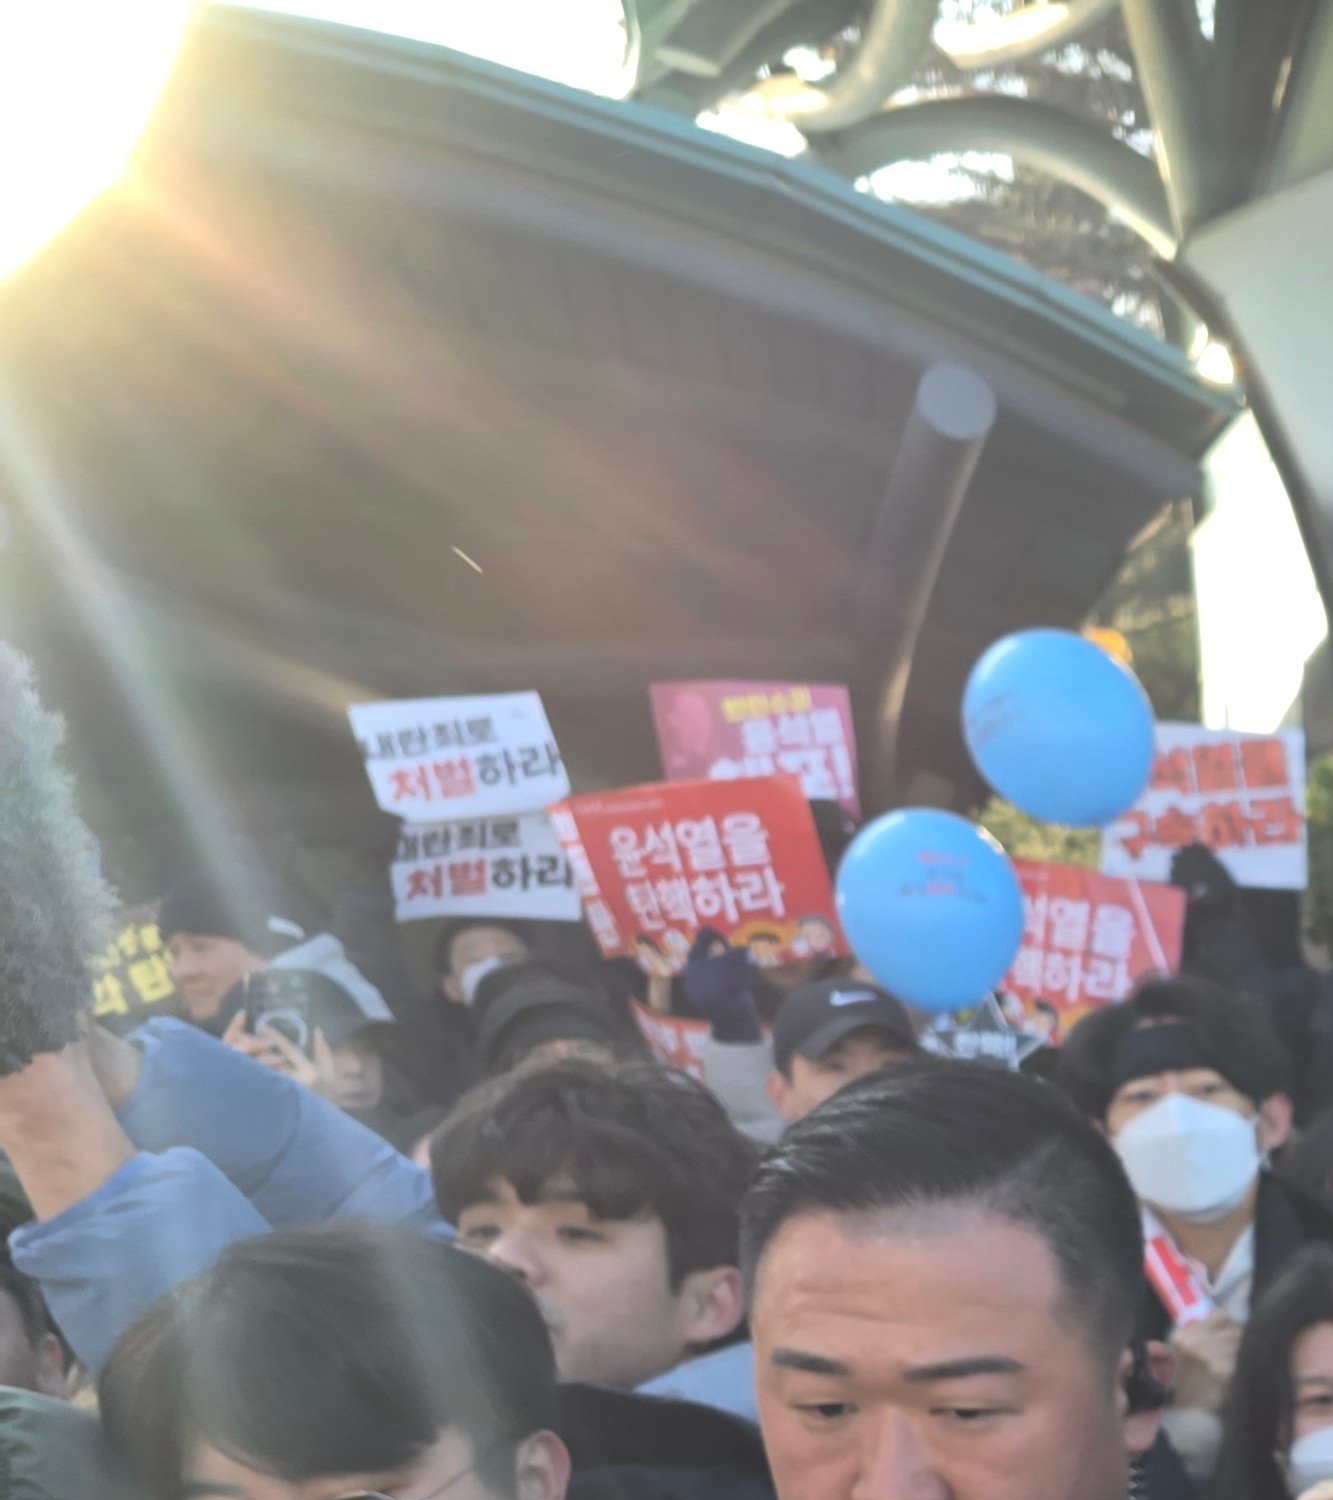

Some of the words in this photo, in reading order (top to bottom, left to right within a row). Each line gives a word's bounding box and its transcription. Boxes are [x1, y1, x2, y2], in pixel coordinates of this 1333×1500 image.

[390, 743, 561, 803] 처벌하라
[609, 811, 770, 879] 윤석열을
[407, 855, 574, 901] 처벌하라
[625, 865, 786, 931] 탄핵하라
